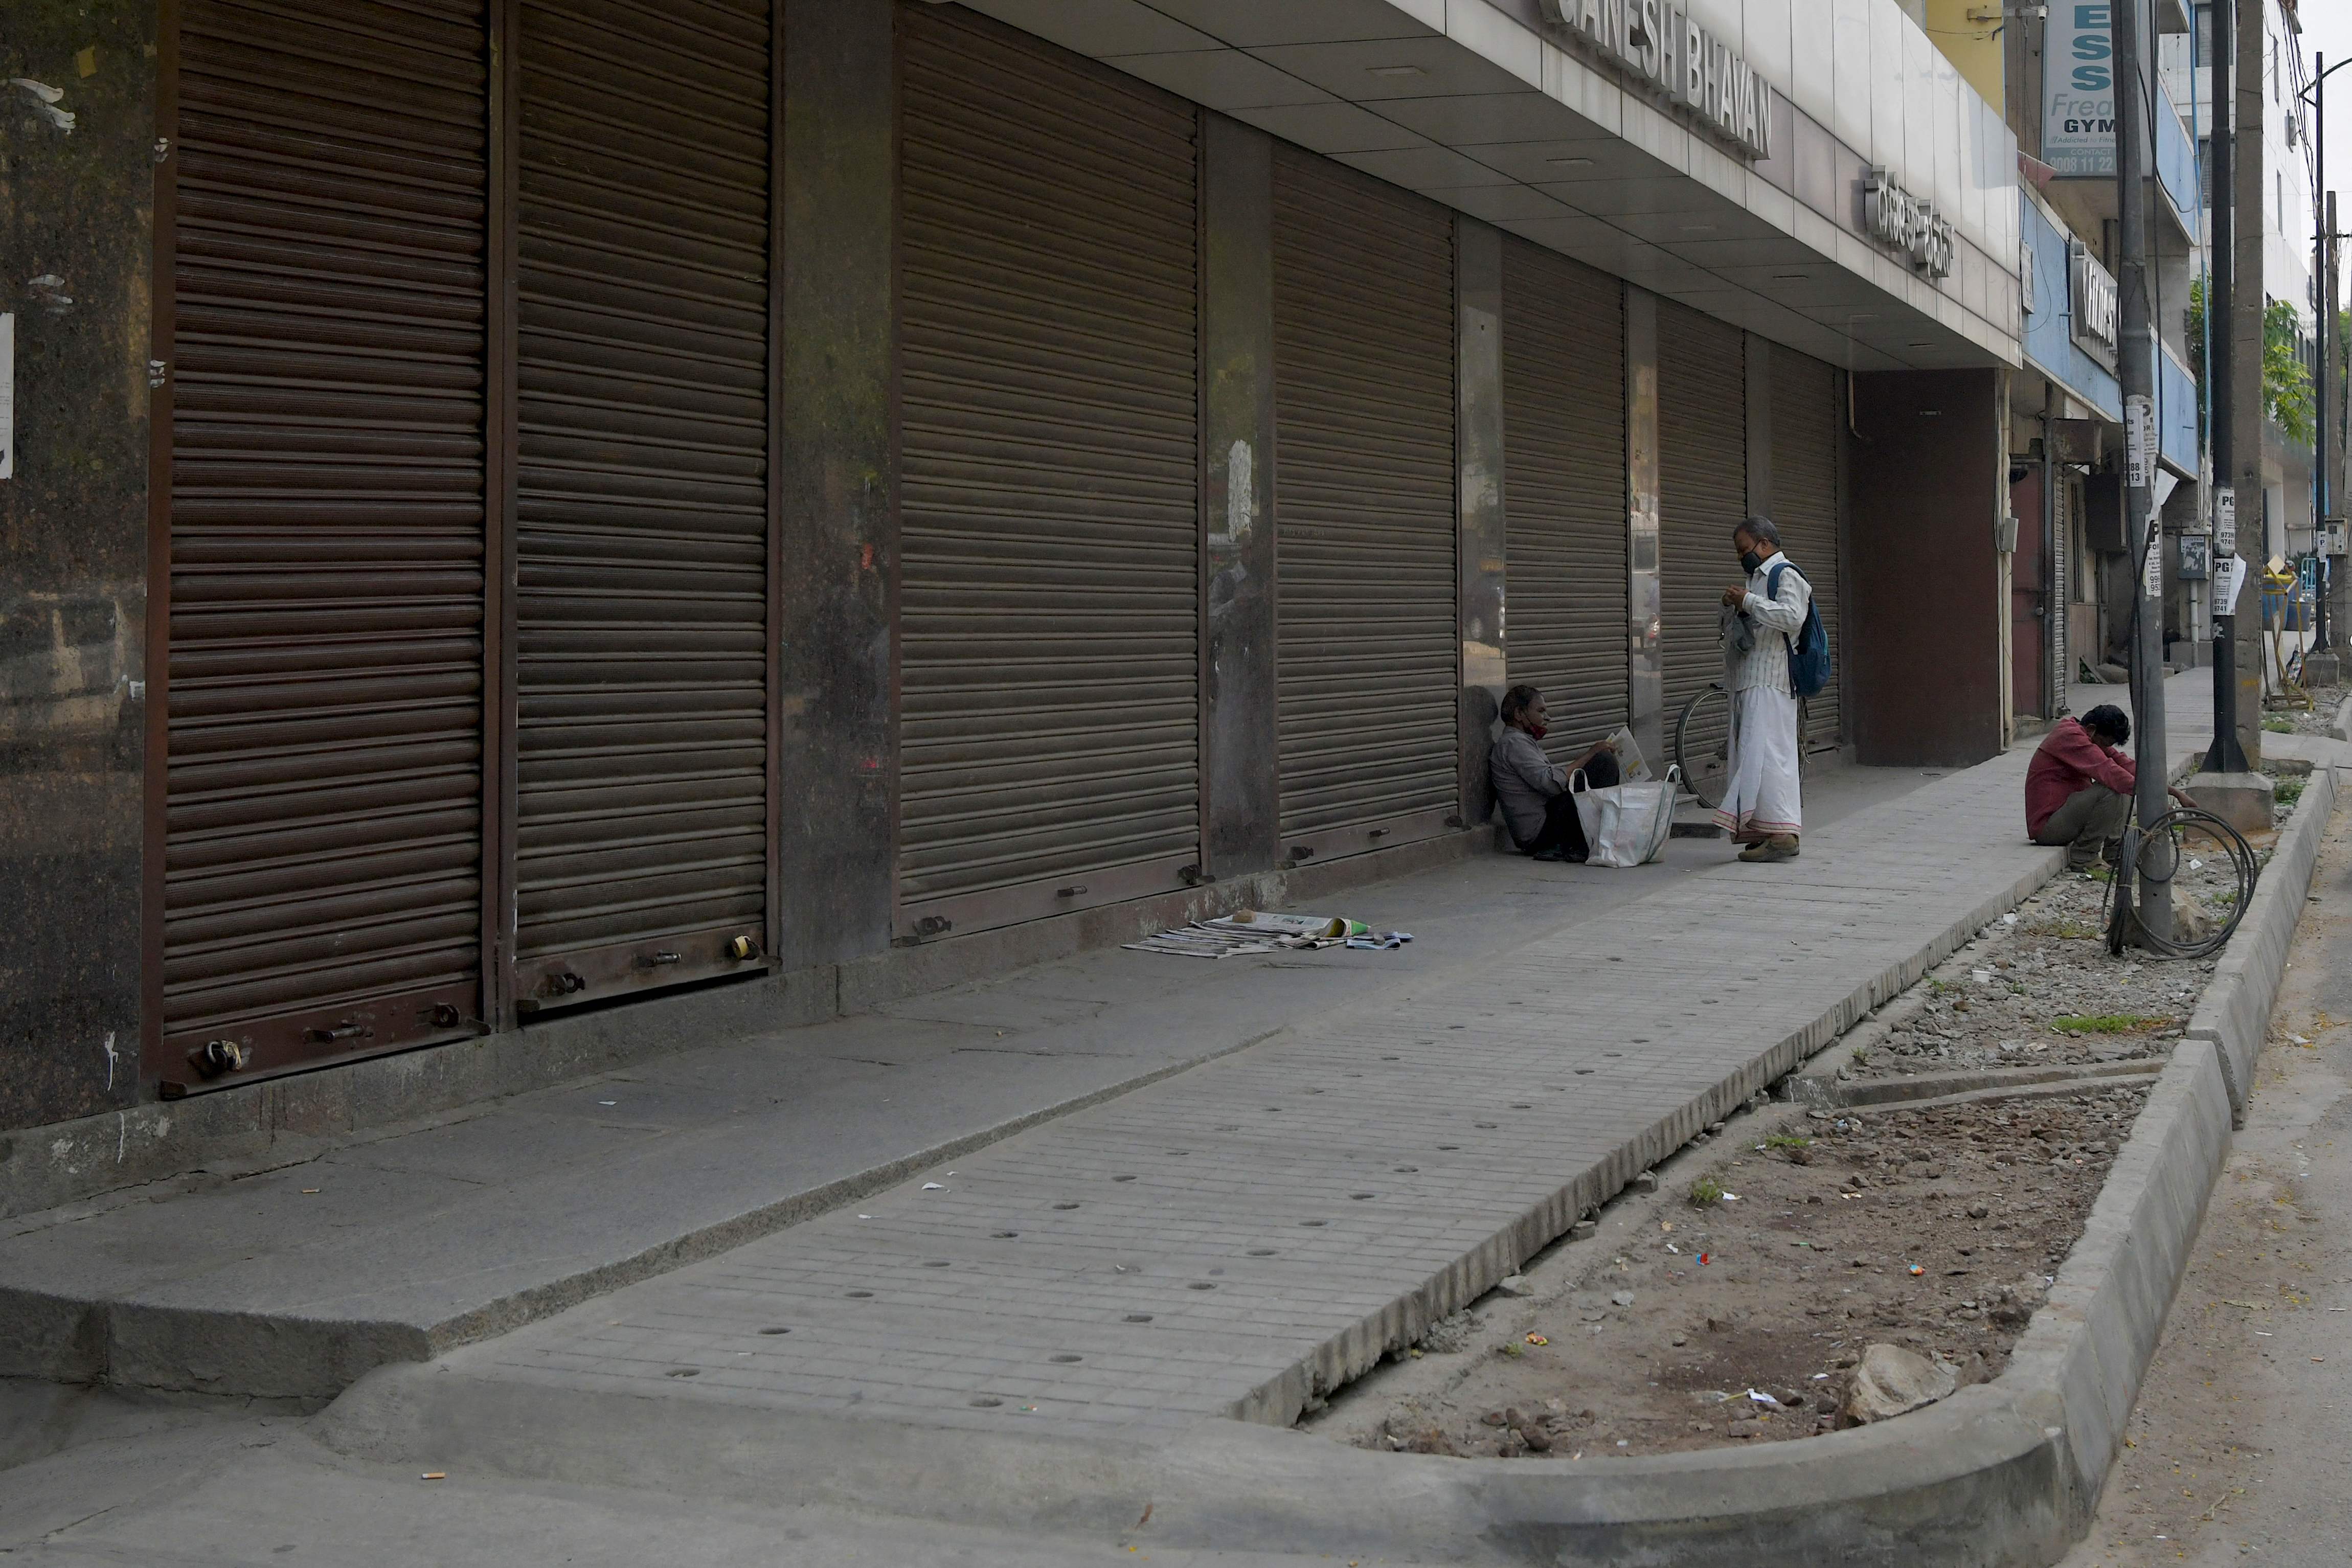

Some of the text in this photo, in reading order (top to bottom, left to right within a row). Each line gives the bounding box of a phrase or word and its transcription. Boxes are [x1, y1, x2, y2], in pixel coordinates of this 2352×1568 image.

[1552, 0, 1772, 160] ANESH BHAVAN
[2051, 94, 2113, 117] Frea
[2064, 119, 2116, 133] GYM
[2081, 157, 2094, 172] 11
[2098, 156, 2113, 172] 22
[2215, 562, 2229, 572] PG
